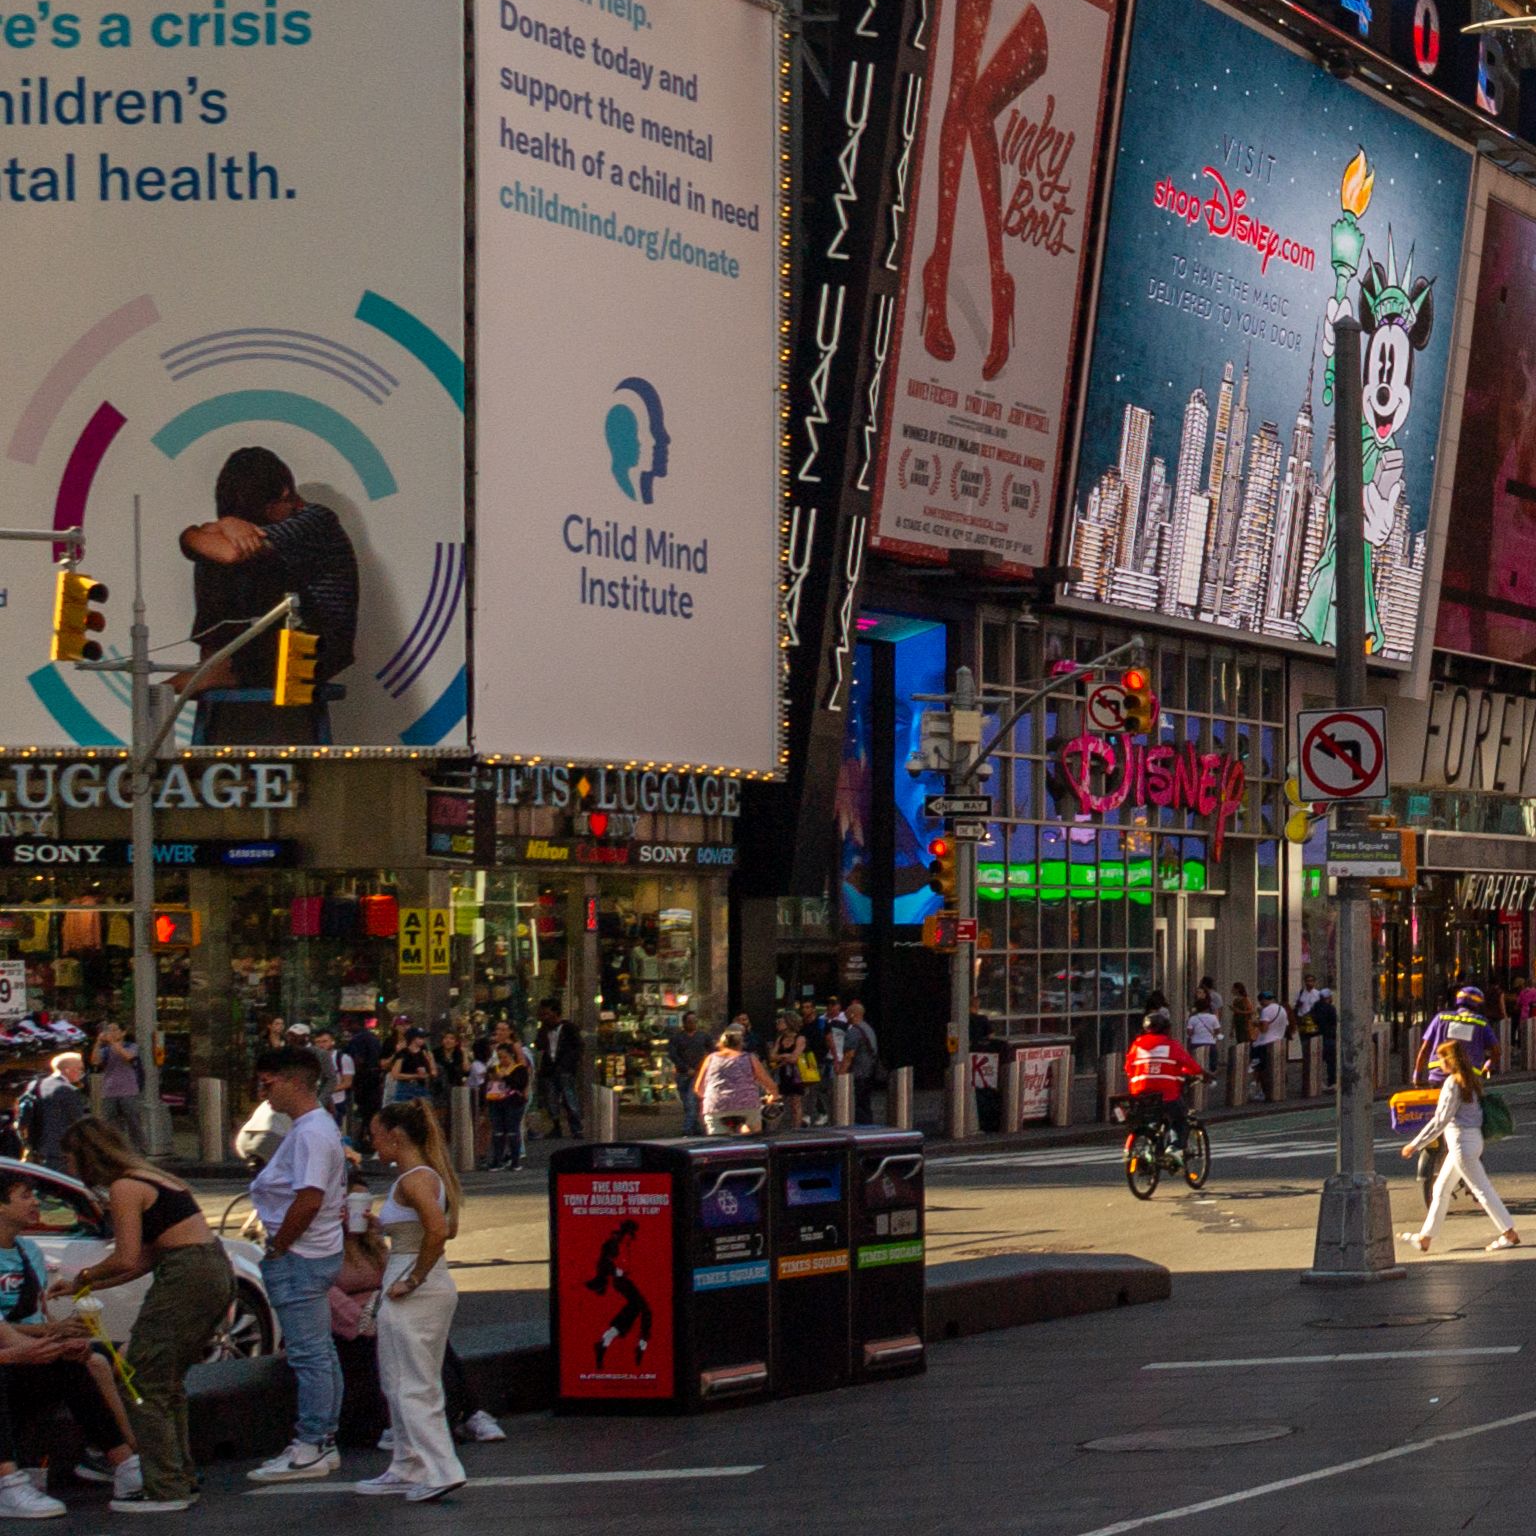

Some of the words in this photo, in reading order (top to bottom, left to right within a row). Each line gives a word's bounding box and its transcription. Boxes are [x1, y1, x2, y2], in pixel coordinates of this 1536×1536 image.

[98, 12, 131, 48] a
[500, 0, 585, 59] Donate
[592, 37, 653, 91] today
[660, 68, 698, 102] and
[500, 66, 593, 120] support
[598, 97, 634, 134] the
[641, 120, 713, 162] mental
[98, 152, 297, 202] health.
[500, 117, 575, 171] health
[582, 151, 605, 180] of
[610, 163, 624, 187] a
[629, 169, 680, 206] child
[687, 182, 705, 215] in
[712, 196, 760, 232] need
[1223, 133, 1276, 186] VISIT
[500, 181, 740, 279] childmind.org/donate
[1172, 254, 1187, 278] TO
[1193, 264, 1223, 294] HAVE
[1228, 276, 1249, 303] THE
[1254, 287, 1288, 318] MAGIC
[1148, 278, 1211, 321] DELIVERED
[1215, 302, 1232, 327] TO
[1236, 314, 1265, 339] YOUR
[1271, 325, 1301, 352] DOOR
[562, 514, 637, 562] Child
[645, 527, 708, 574] Mind
[580, 566, 693, 619] Institute
[599, 770, 741, 816] LUGGAGE
[14, 845, 104, 863] SONY
[229, 849, 275, 859] SAMSUNG
[526, 840, 569, 860] Nikon
[640, 846, 690, 863] SONY
[1463, 873, 1527, 911] FOREVER
